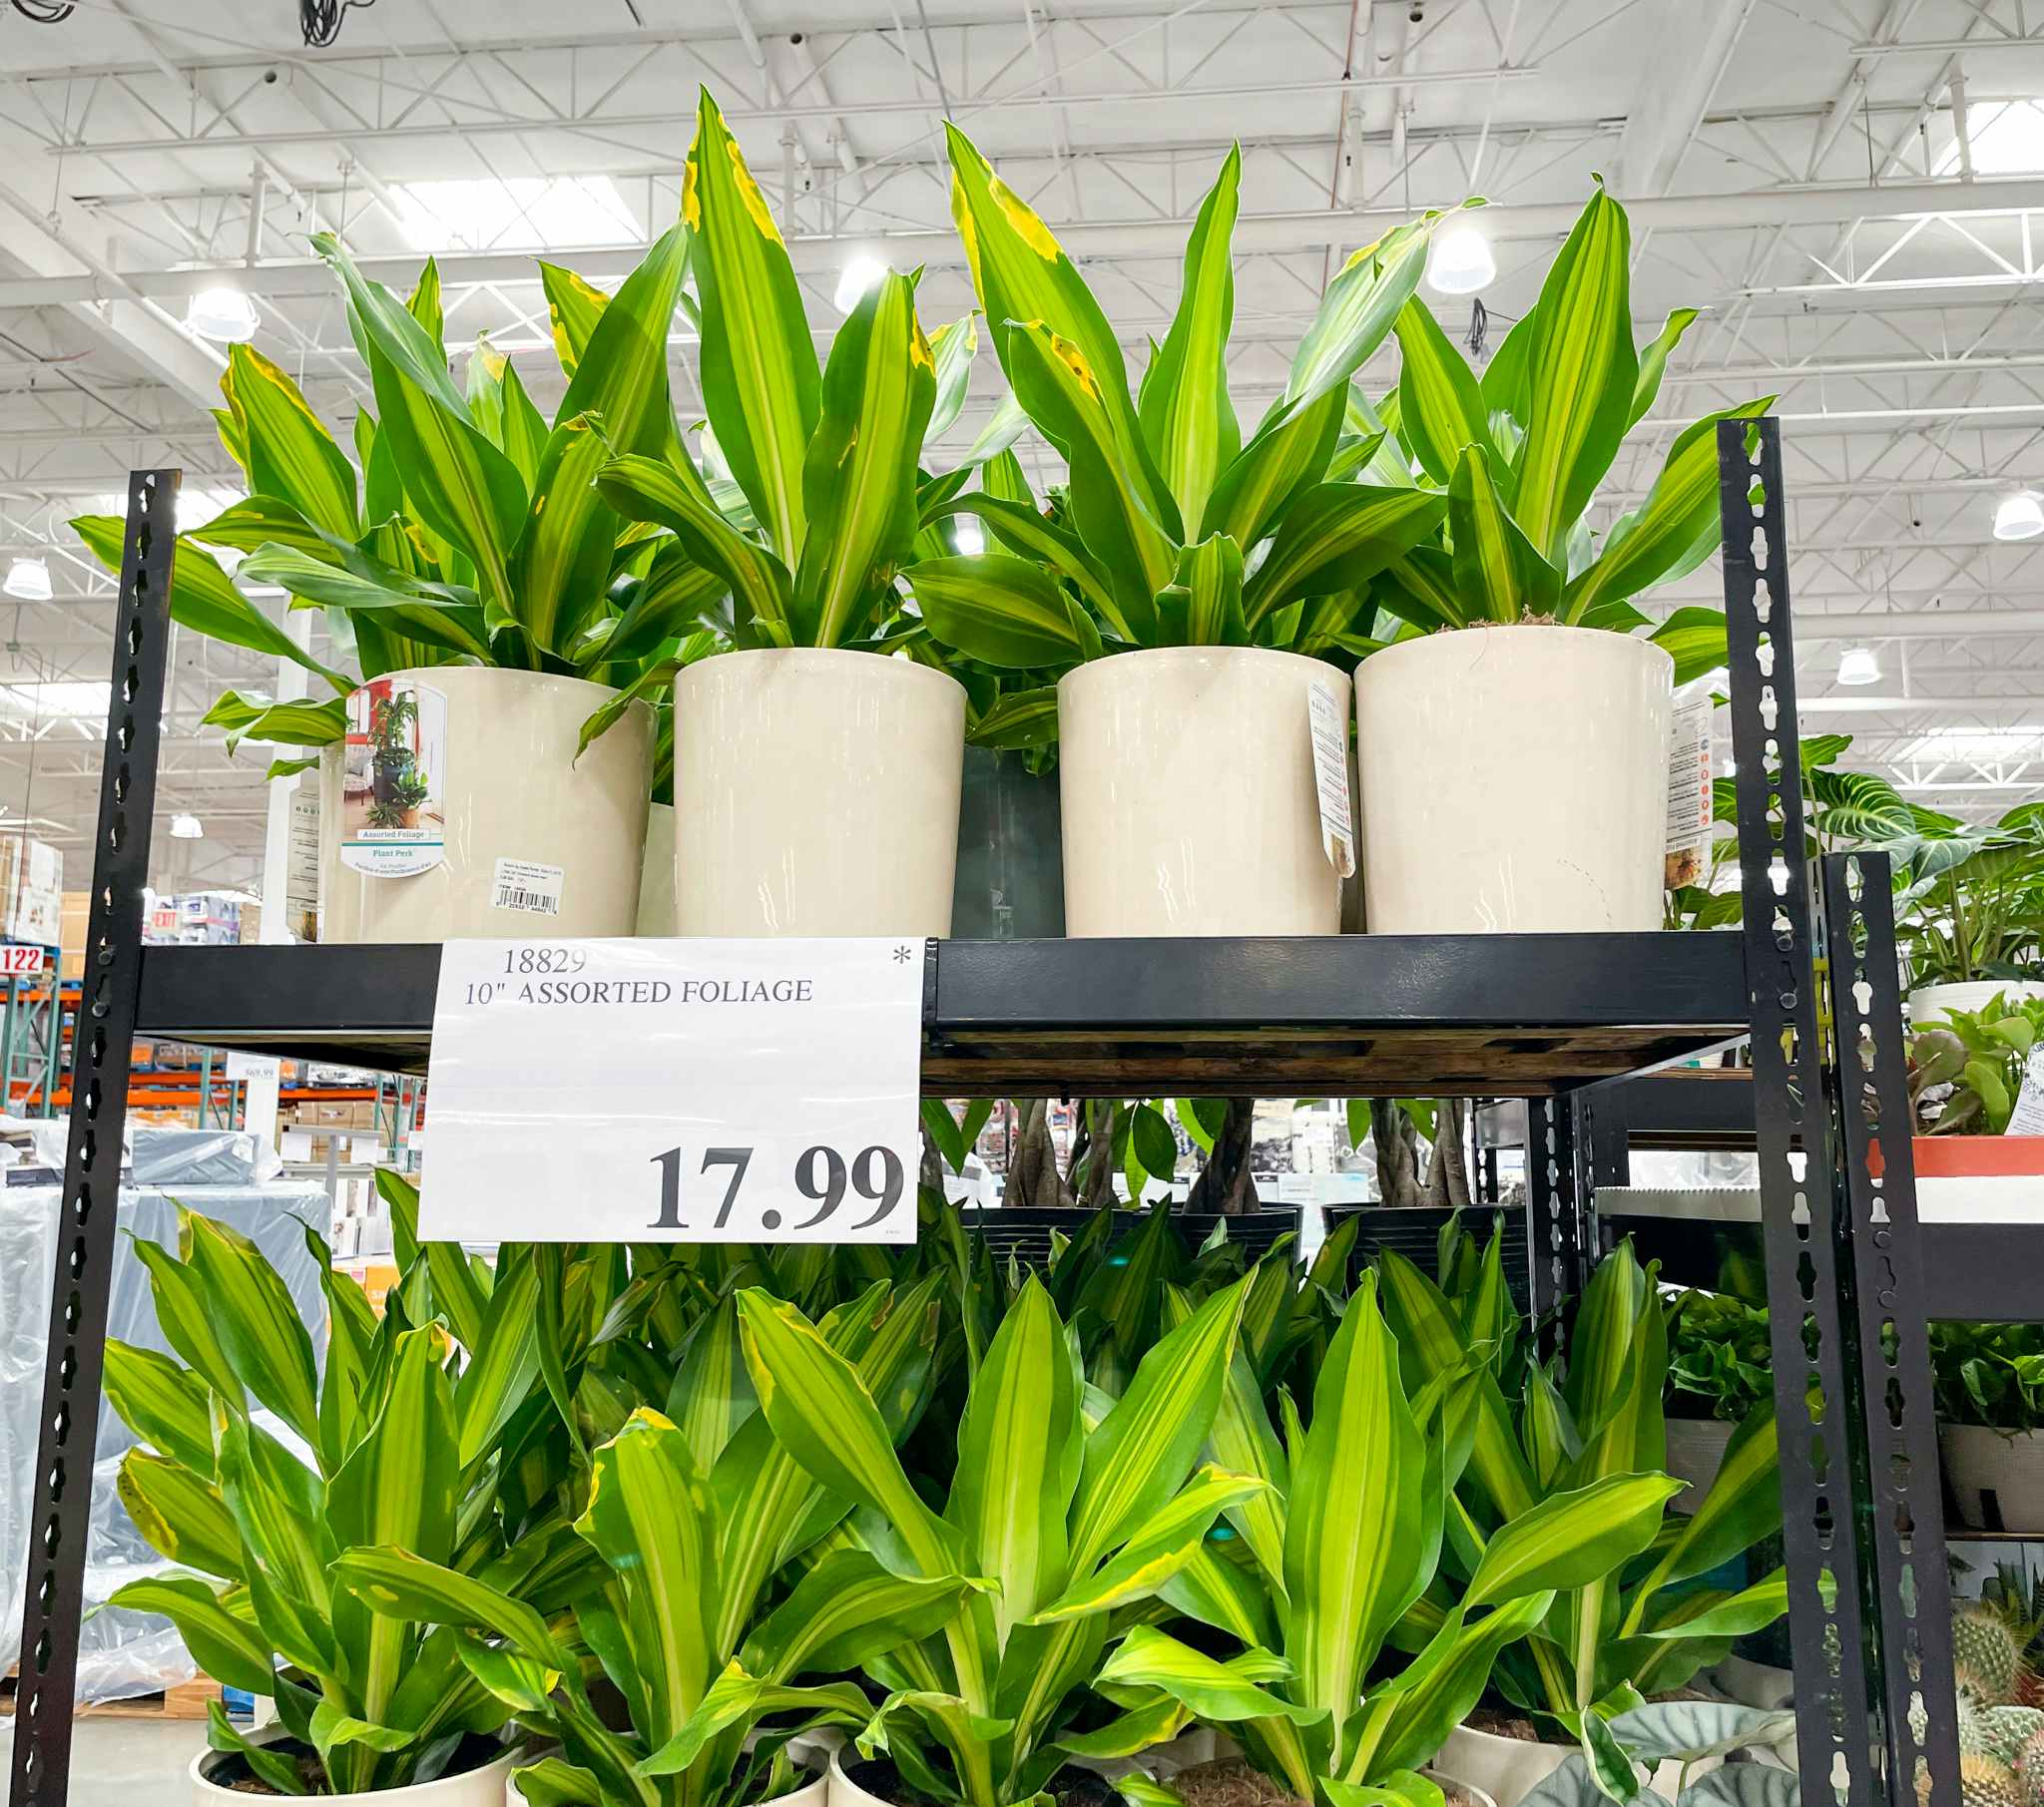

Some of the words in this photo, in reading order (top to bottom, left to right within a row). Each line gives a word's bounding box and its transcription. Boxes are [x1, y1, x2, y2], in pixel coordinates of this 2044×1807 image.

[398, 830, 424, 839] Foliage
[154, 911, 177, 927] EXIT
[4, 948, 39, 972] 122
[503, 948, 587, 974] 18829
[465, 982, 505, 1005] 10"
[518, 981, 672, 1004] ASSORTED
[681, 980, 813, 1003] FOLIAGE
[646, 1145, 904, 1230] 17.99
